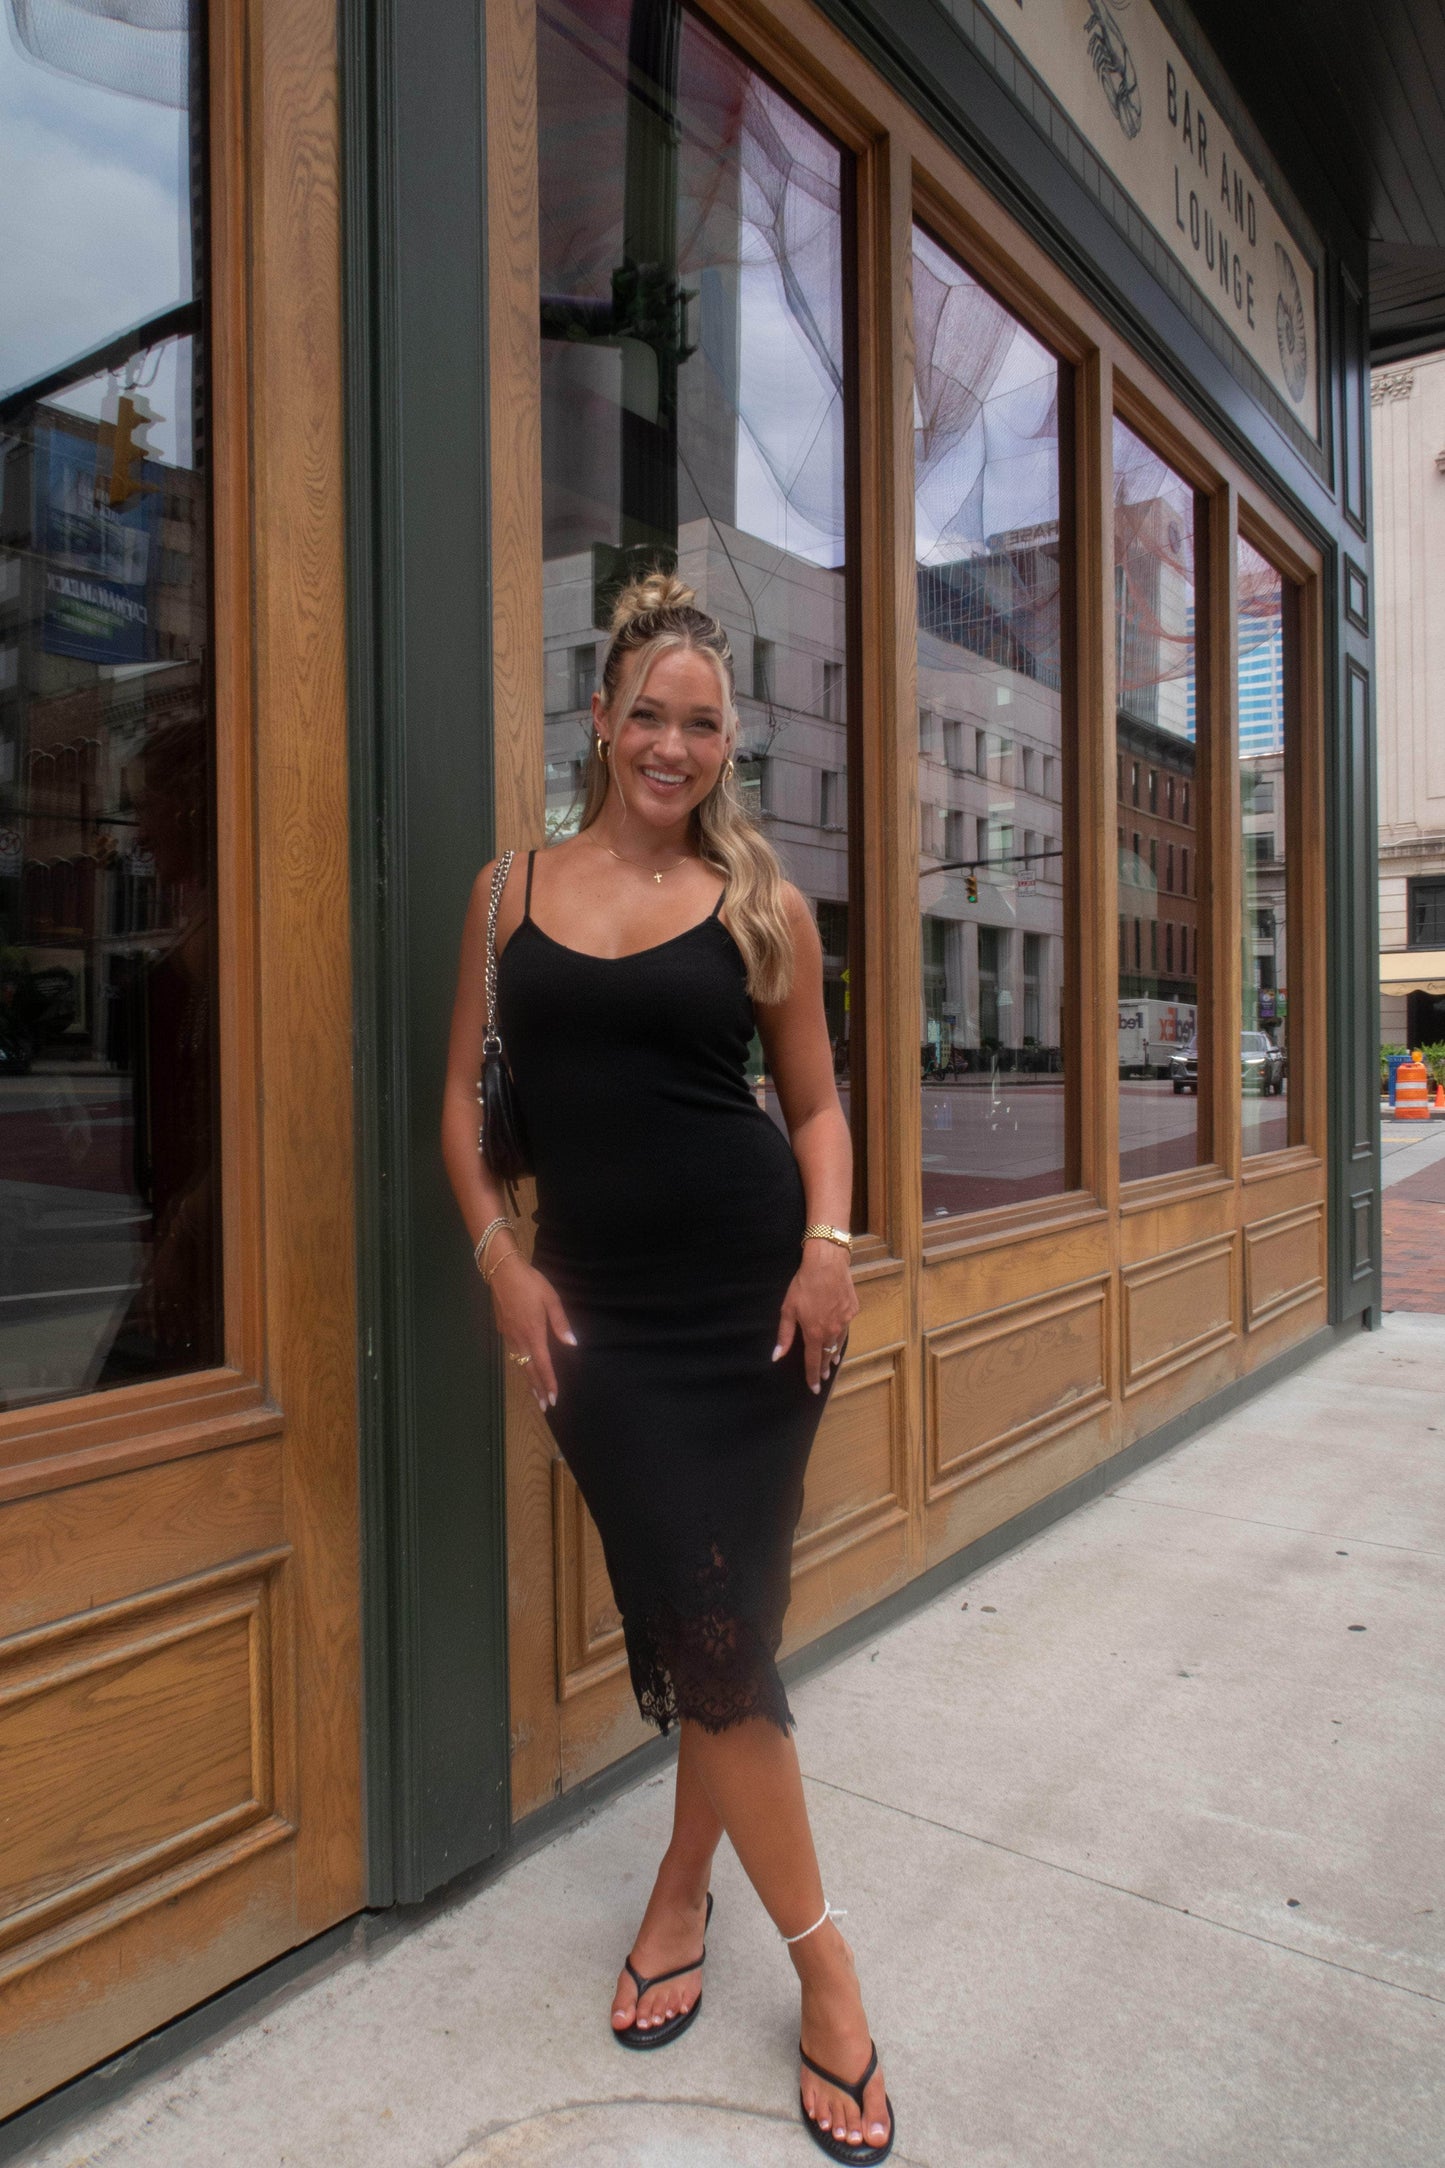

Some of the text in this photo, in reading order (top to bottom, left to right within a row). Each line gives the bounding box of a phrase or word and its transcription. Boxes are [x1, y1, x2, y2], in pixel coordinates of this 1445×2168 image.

[1166, 60, 1256, 248] BAR AND
[1174, 164, 1255, 331] LOUNGE
